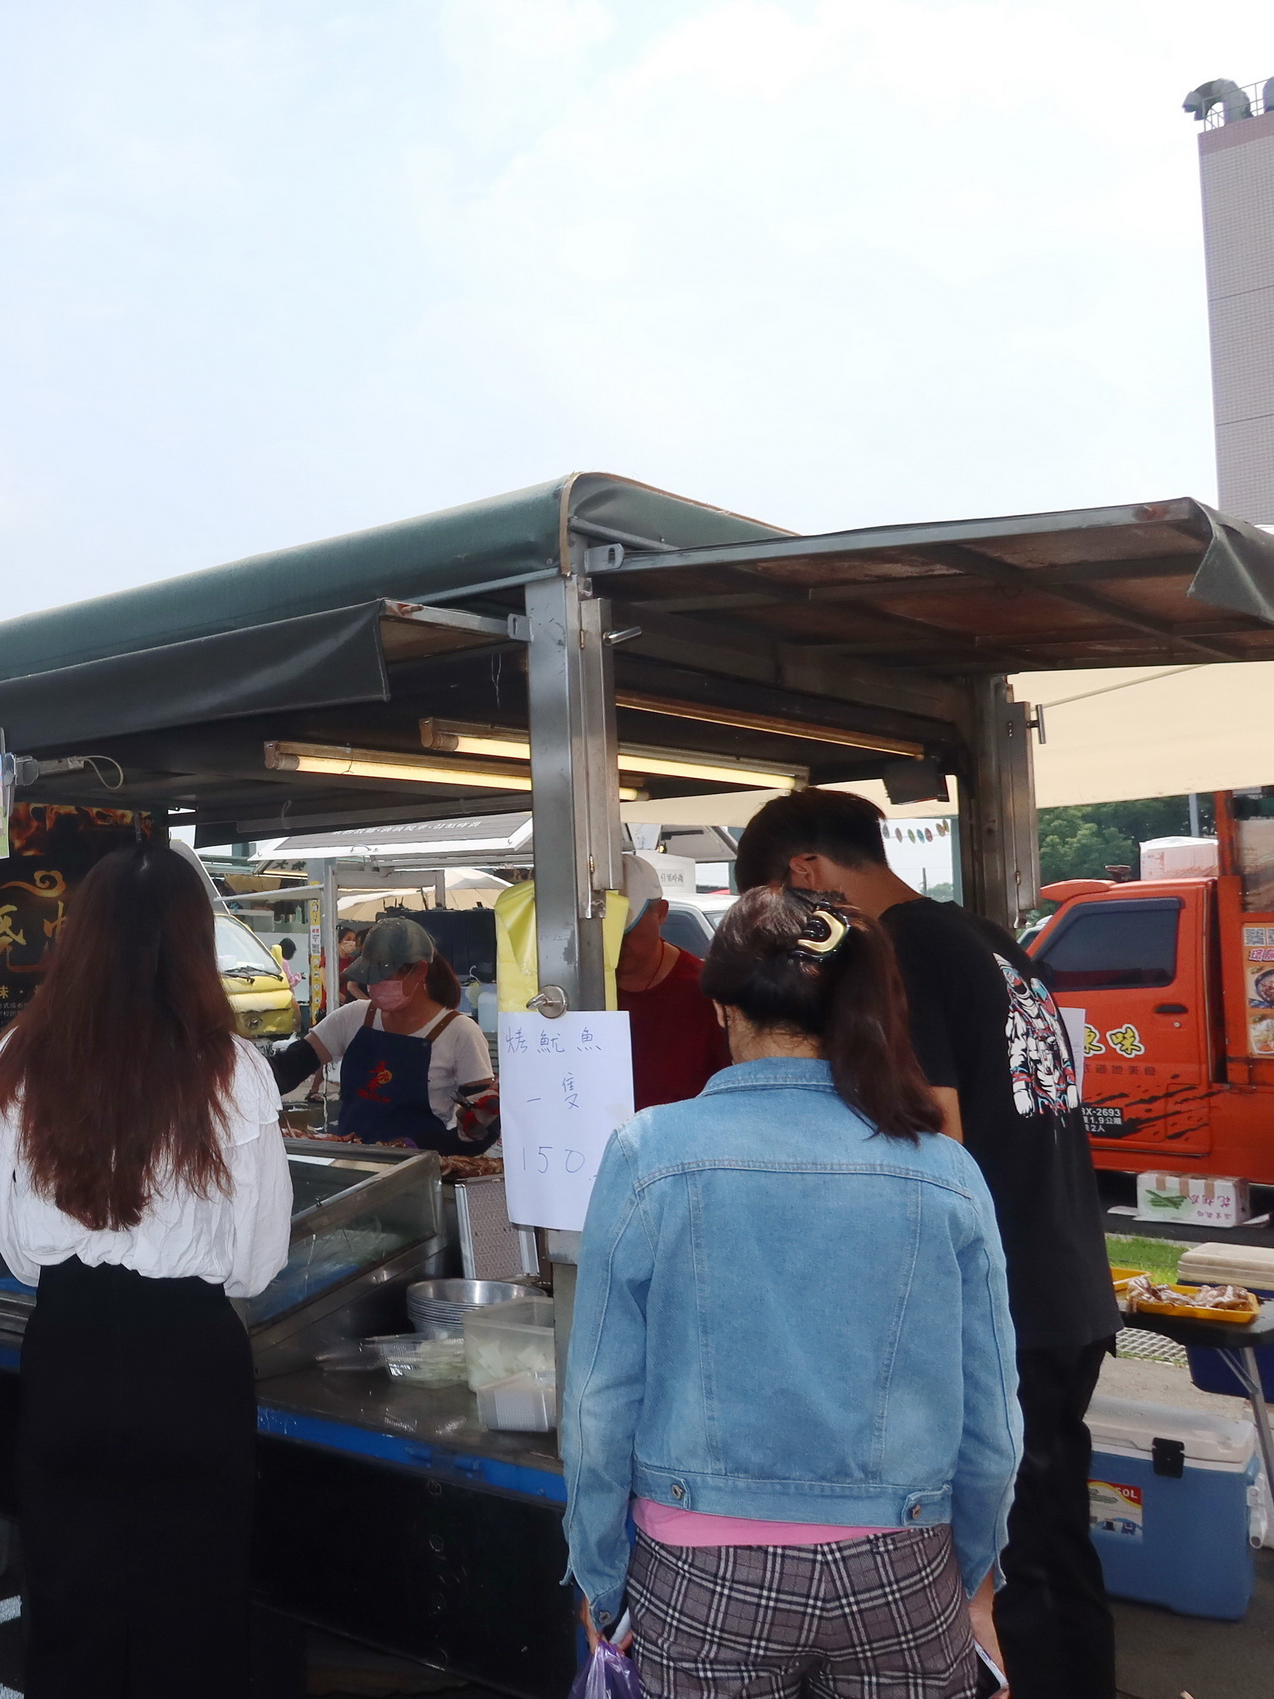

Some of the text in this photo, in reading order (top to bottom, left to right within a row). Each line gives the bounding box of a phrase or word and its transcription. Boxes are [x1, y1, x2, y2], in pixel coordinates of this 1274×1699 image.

[505, 1026, 602, 1054] 烤魷魚
[526, 1072, 579, 1110] 一隻
